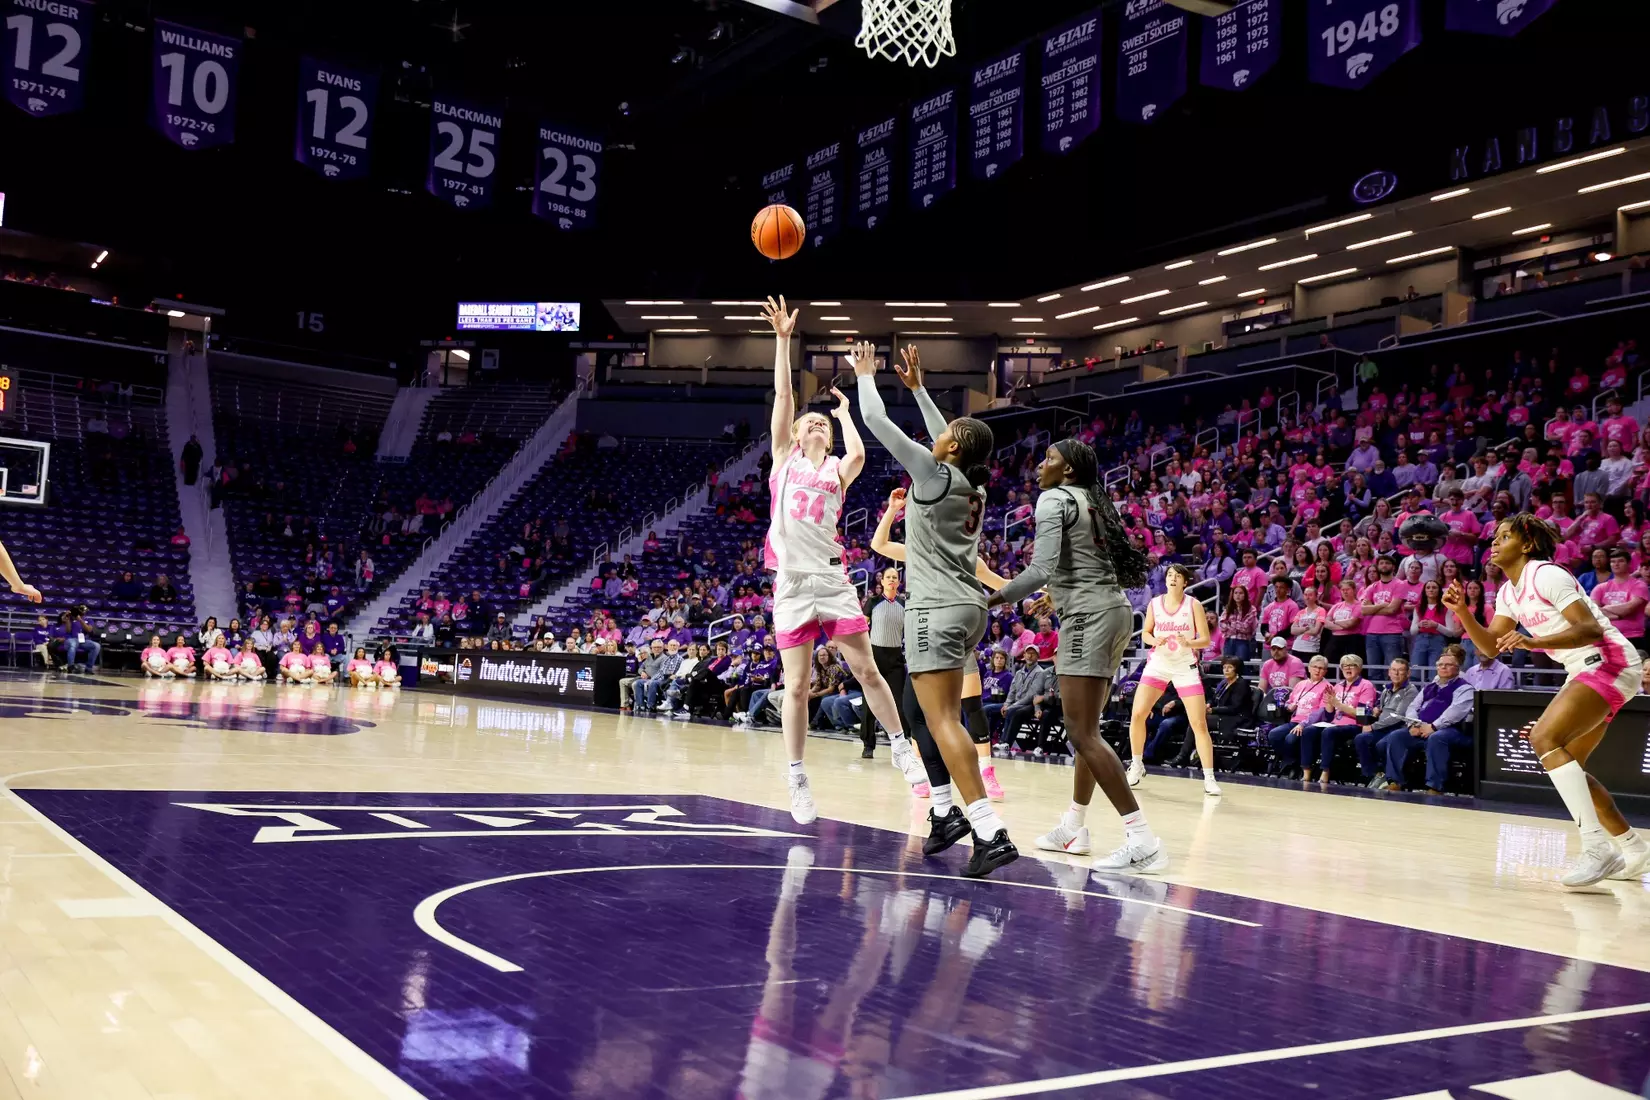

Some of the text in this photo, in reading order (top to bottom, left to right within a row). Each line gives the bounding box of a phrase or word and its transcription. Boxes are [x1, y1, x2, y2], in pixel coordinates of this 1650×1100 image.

[1144, 18, 1160, 30] NCAA
[1217, 11, 1268, 28] 1951 1972
[1045, 18, 1097, 53] K-STATE
[1121, 16, 1184, 52] SWEET SIXTEEN
[1216, 24, 1268, 41] 1958 1973
[1322, 4, 1399, 57] 1948
[6, 14, 81, 82] 12
[161, 30, 234, 59] WILLIAMS
[1216, 37, 1269, 54] 1959 1975
[1128, 49, 1148, 65] 2018
[1216, 50, 1236, 66] 1961
[974, 53, 1021, 84] K-STATE
[1041, 54, 1097, 87] SWEET SIXTEEN
[1128, 61, 1147, 76] 2023
[13, 79, 66, 99] 1971-74
[160, 52, 229, 114] 10
[317, 70, 362, 91] EVANS
[1049, 75, 1088, 98] 1972 1981
[912, 89, 953, 119] K-STATE
[969, 86, 1021, 116] SWEET SIXTEEN
[1048, 86, 1088, 110] 1973 1982
[167, 114, 216, 133] 1972-76
[306, 88, 368, 149] 12
[434, 101, 502, 128] BLACKMAN
[977, 106, 1012, 127] 1951 1961
[1047, 109, 1087, 132] 1977 2010
[1048, 107, 1064, 121] 1975
[858, 118, 895, 144] K-STATE
[920, 121, 942, 139] NCAA
[976, 116, 1012, 138] 1956 1964
[434, 121, 495, 178] 25
[540, 128, 603, 153] RICHMOND
[915, 140, 947, 160] 2011 2017
[975, 138, 1011, 159] 1959 1970
[310, 147, 357, 165] 1974-78
[806, 142, 840, 167] K-STATE
[865, 147, 885, 163] NCAA
[914, 150, 946, 170] 2012 2018
[540, 147, 596, 202] 23
[913, 160, 946, 180] 2013 2019
[913, 170, 945, 189] 2014 2023
[443, 178, 485, 195] 1977-81
[548, 201, 586, 218] 1986-88
[296, 311, 325, 332] 15
[790, 490, 826, 525] 34
[965, 496, 982, 535] 3
[918, 616, 928, 624] &
[1075, 623, 1085, 632] &
[1156, 621, 1190, 632] Wildcats
[918, 624, 929, 653] LOYAL
[1071, 631, 1085, 659] LOYAL
[1167, 634, 1178, 652] 6
[479, 656, 569, 693] itmattersks.org
